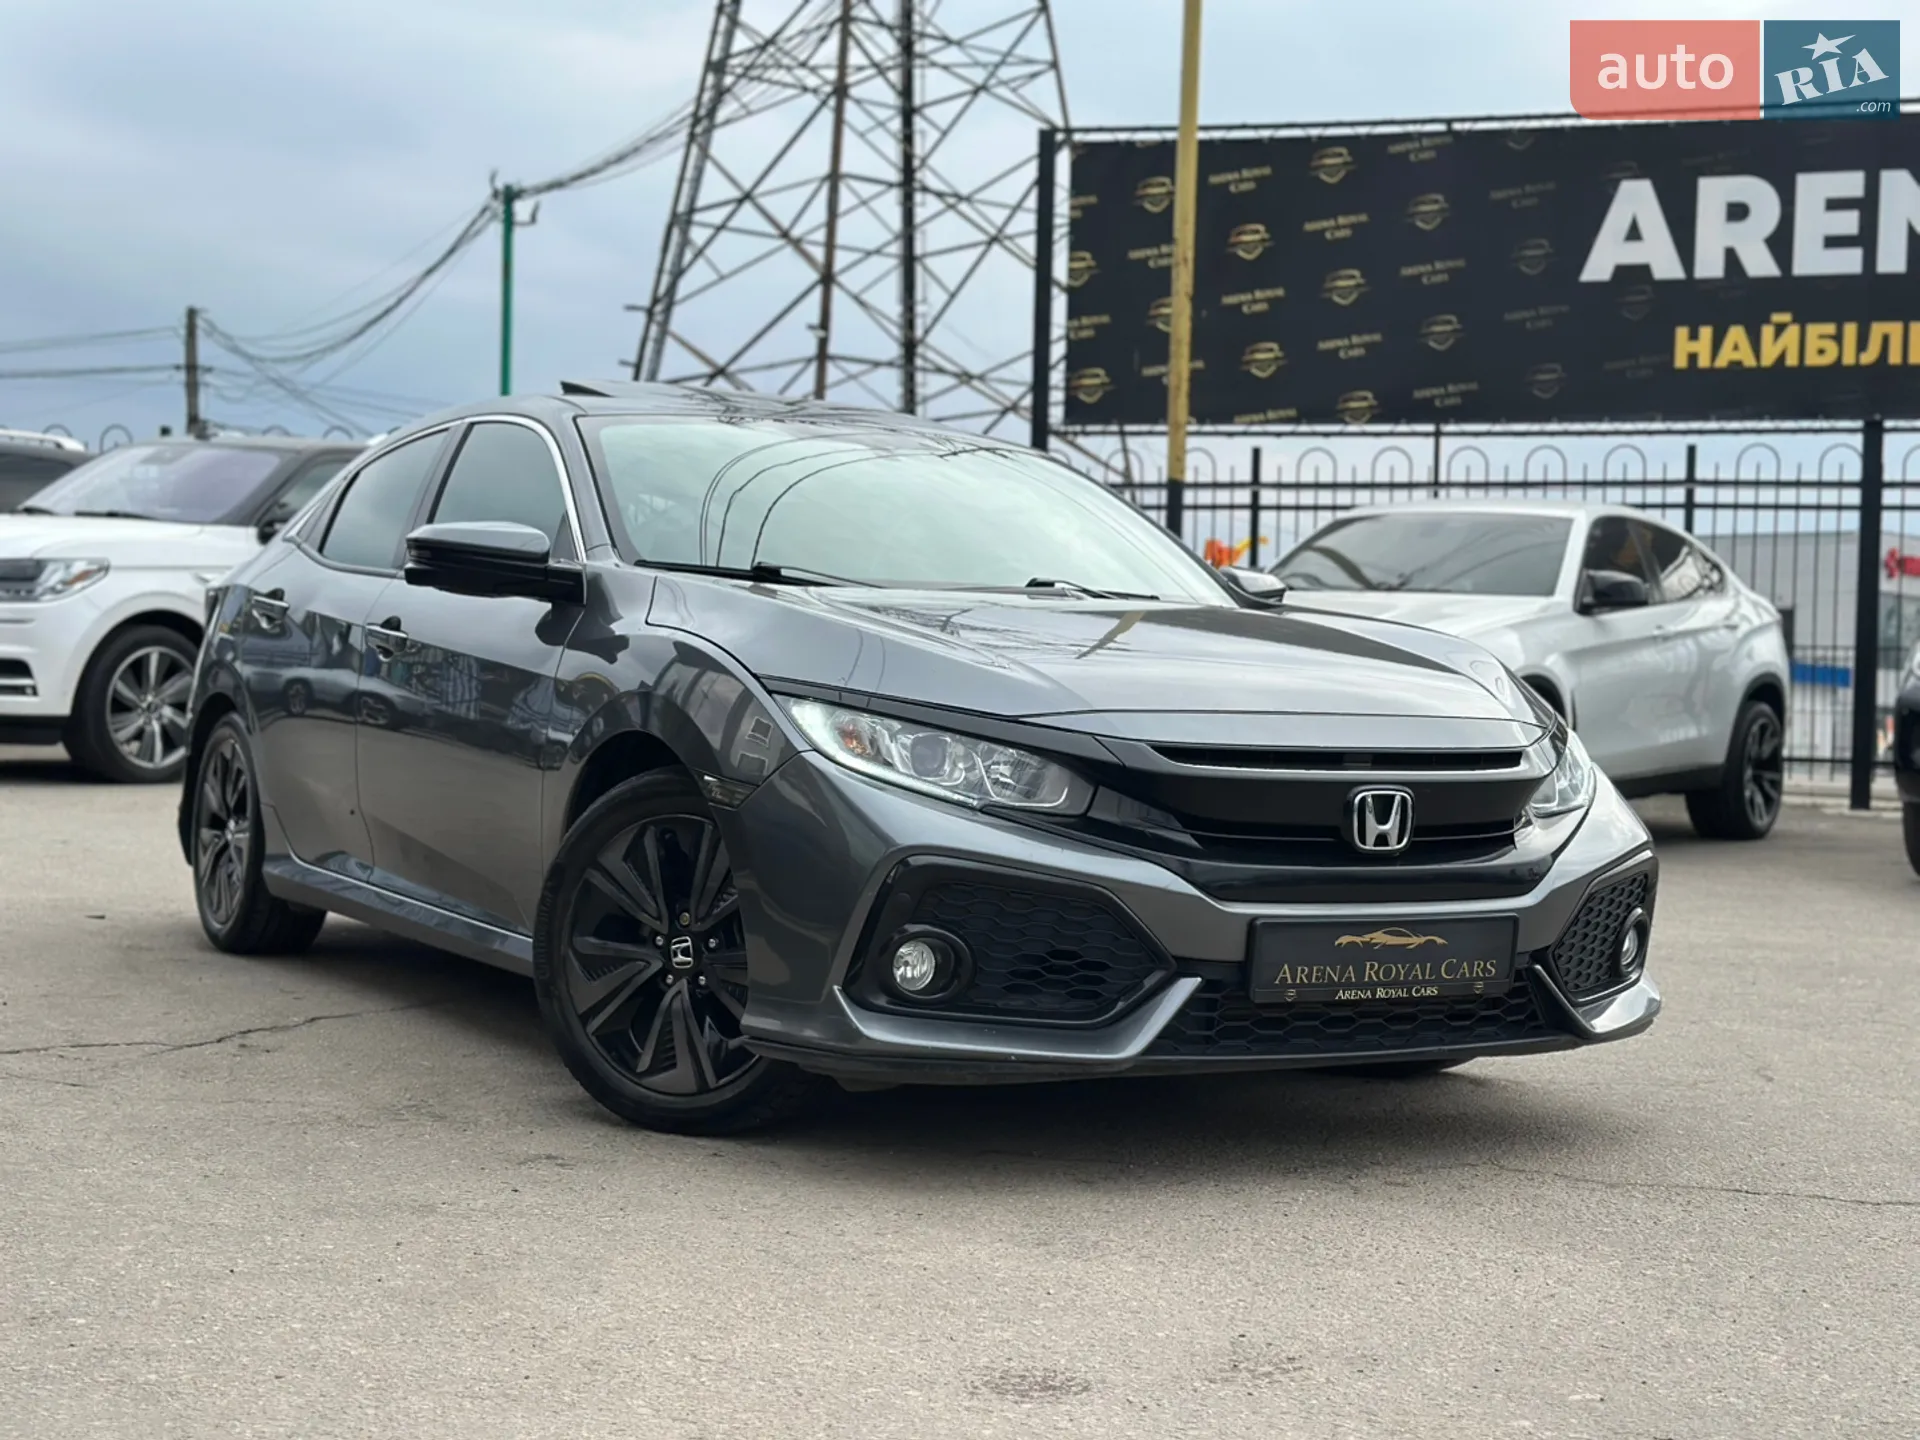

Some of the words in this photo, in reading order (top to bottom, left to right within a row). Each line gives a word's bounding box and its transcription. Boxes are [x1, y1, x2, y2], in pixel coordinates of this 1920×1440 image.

[1274, 964, 1356, 984] ARENA
[1363, 960, 1436, 982] ROYAL
[1440, 959, 1497, 980] CARS
[1335, 988, 1372, 1000] ARENA
[1375, 987, 1409, 998] ROYAL
[1411, 986, 1439, 997] CARS
